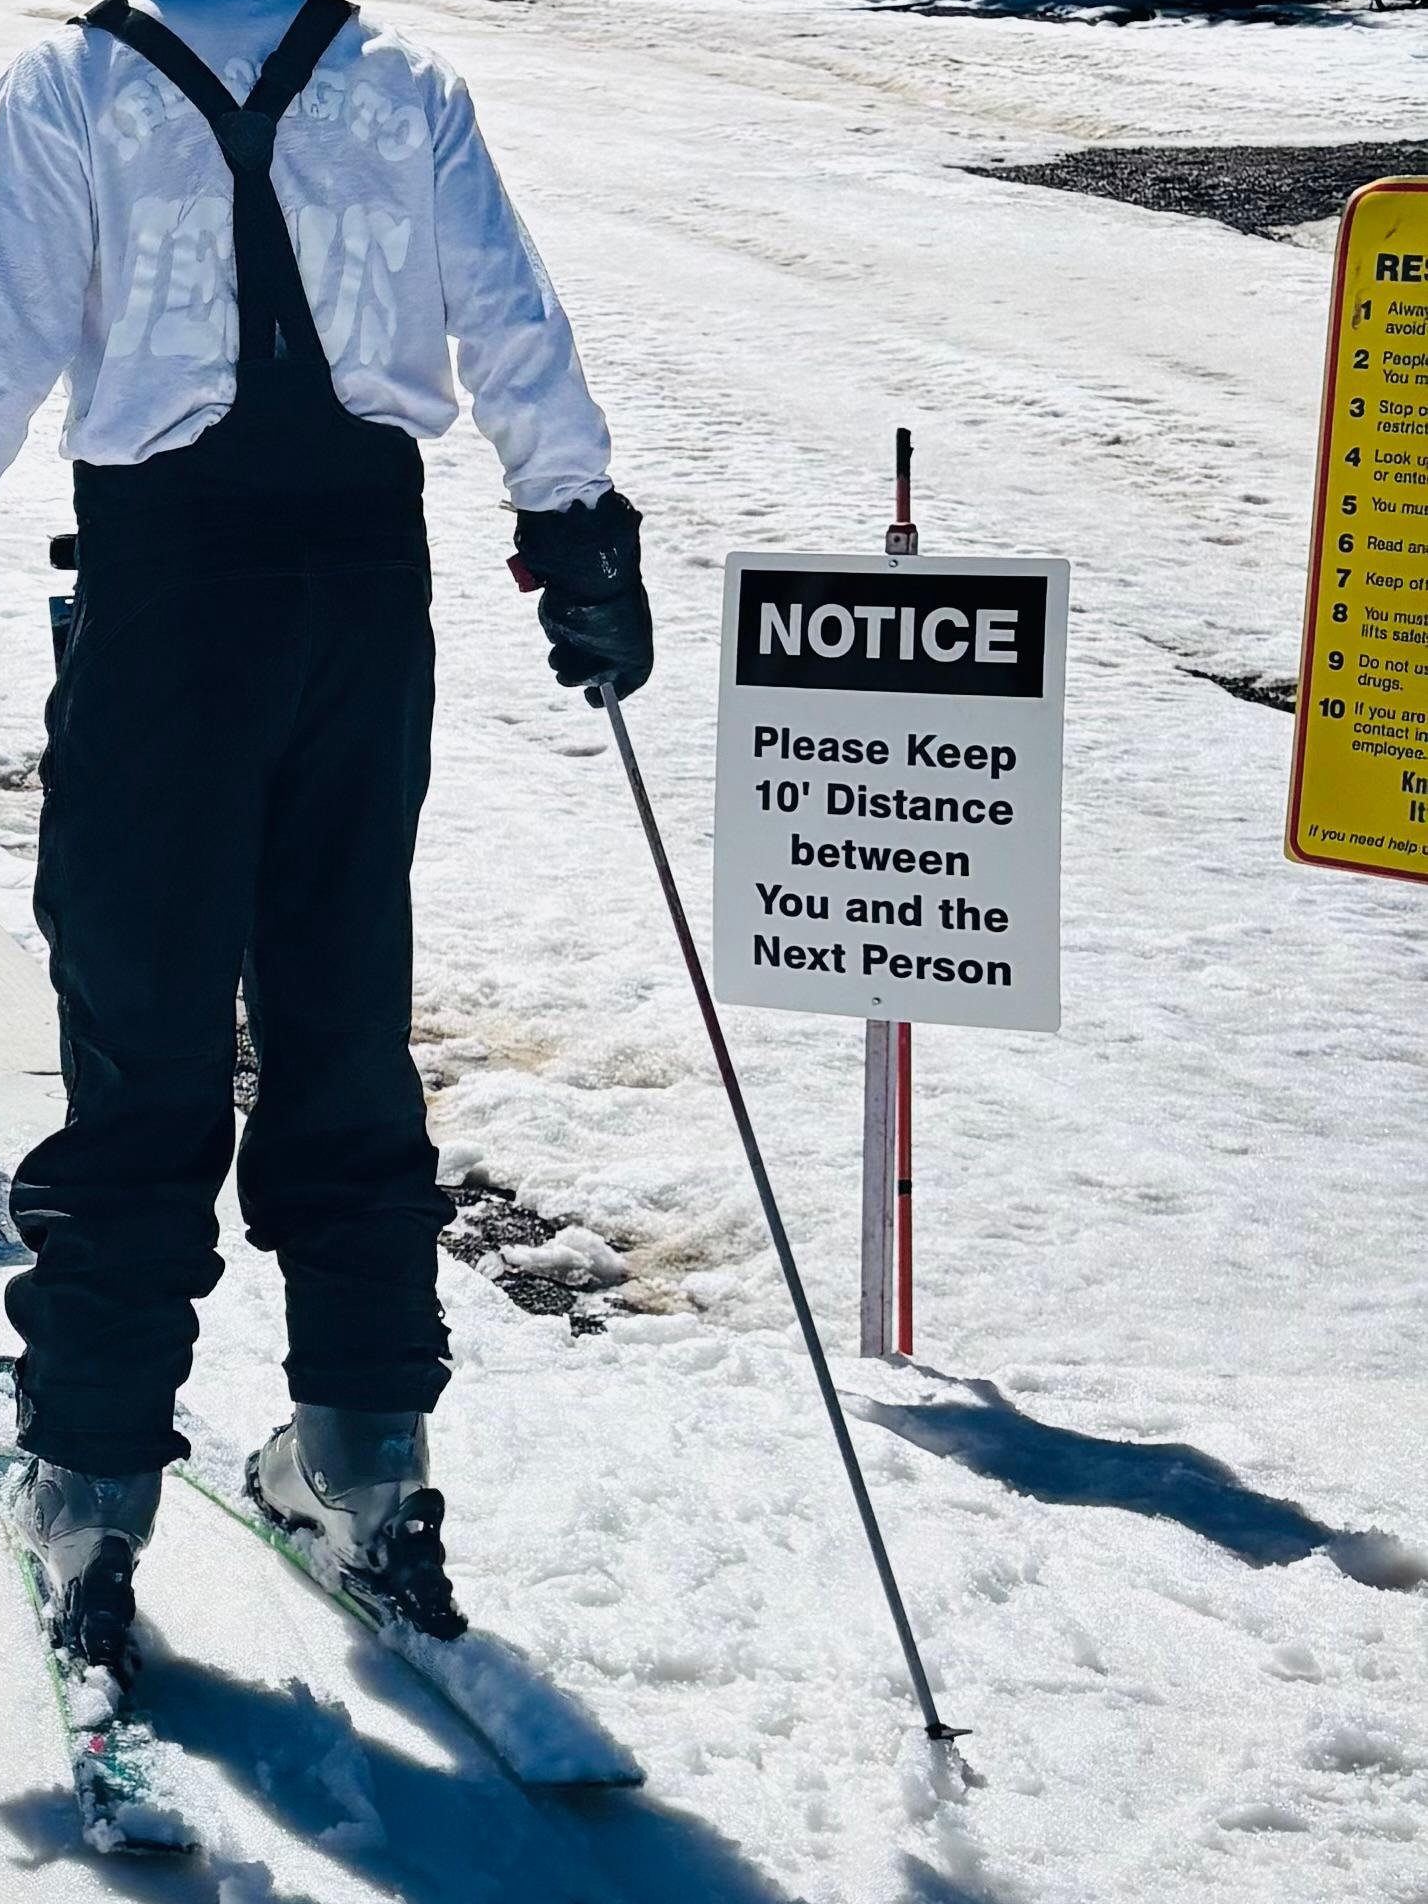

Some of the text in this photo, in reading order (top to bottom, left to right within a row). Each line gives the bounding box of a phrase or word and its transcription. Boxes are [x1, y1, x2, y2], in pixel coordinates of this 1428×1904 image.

[1360, 299, 1372, 320] 1
[1386, 322, 1426, 335] avoid
[1353, 349, 1369, 369] 2
[1383, 369, 1409, 383] You
[1350, 398, 1413, 418] 3 Stop
[1345, 447, 1410, 467] 4 Look
[1374, 471, 1389, 481] or
[1342, 495, 1396, 515] 5 You
[1339, 534, 1403, 552] 6 Read
[1337, 568, 1403, 591] 7 Keep
[1333, 603, 1388, 622] 8 You
[760, 603, 1018, 663] NOTICE
[1362, 624, 1387, 639] lifts
[1329, 651, 1408, 673] 9 Do not
[1357, 673, 1404, 692] drugs.
[1319, 698, 1345, 718] 10
[1355, 702, 1364, 715] If
[1369, 707, 1396, 720] you
[1354, 722, 1410, 740] contact
[755, 726, 1016, 779] Please Keep
[756, 780, 1014, 826] 10' Distance
[1309, 825, 1417, 855] If you need help
[792, 834, 969, 876] between
[756, 883, 1008, 932] You and the
[755, 935, 1012, 987] Next Person
